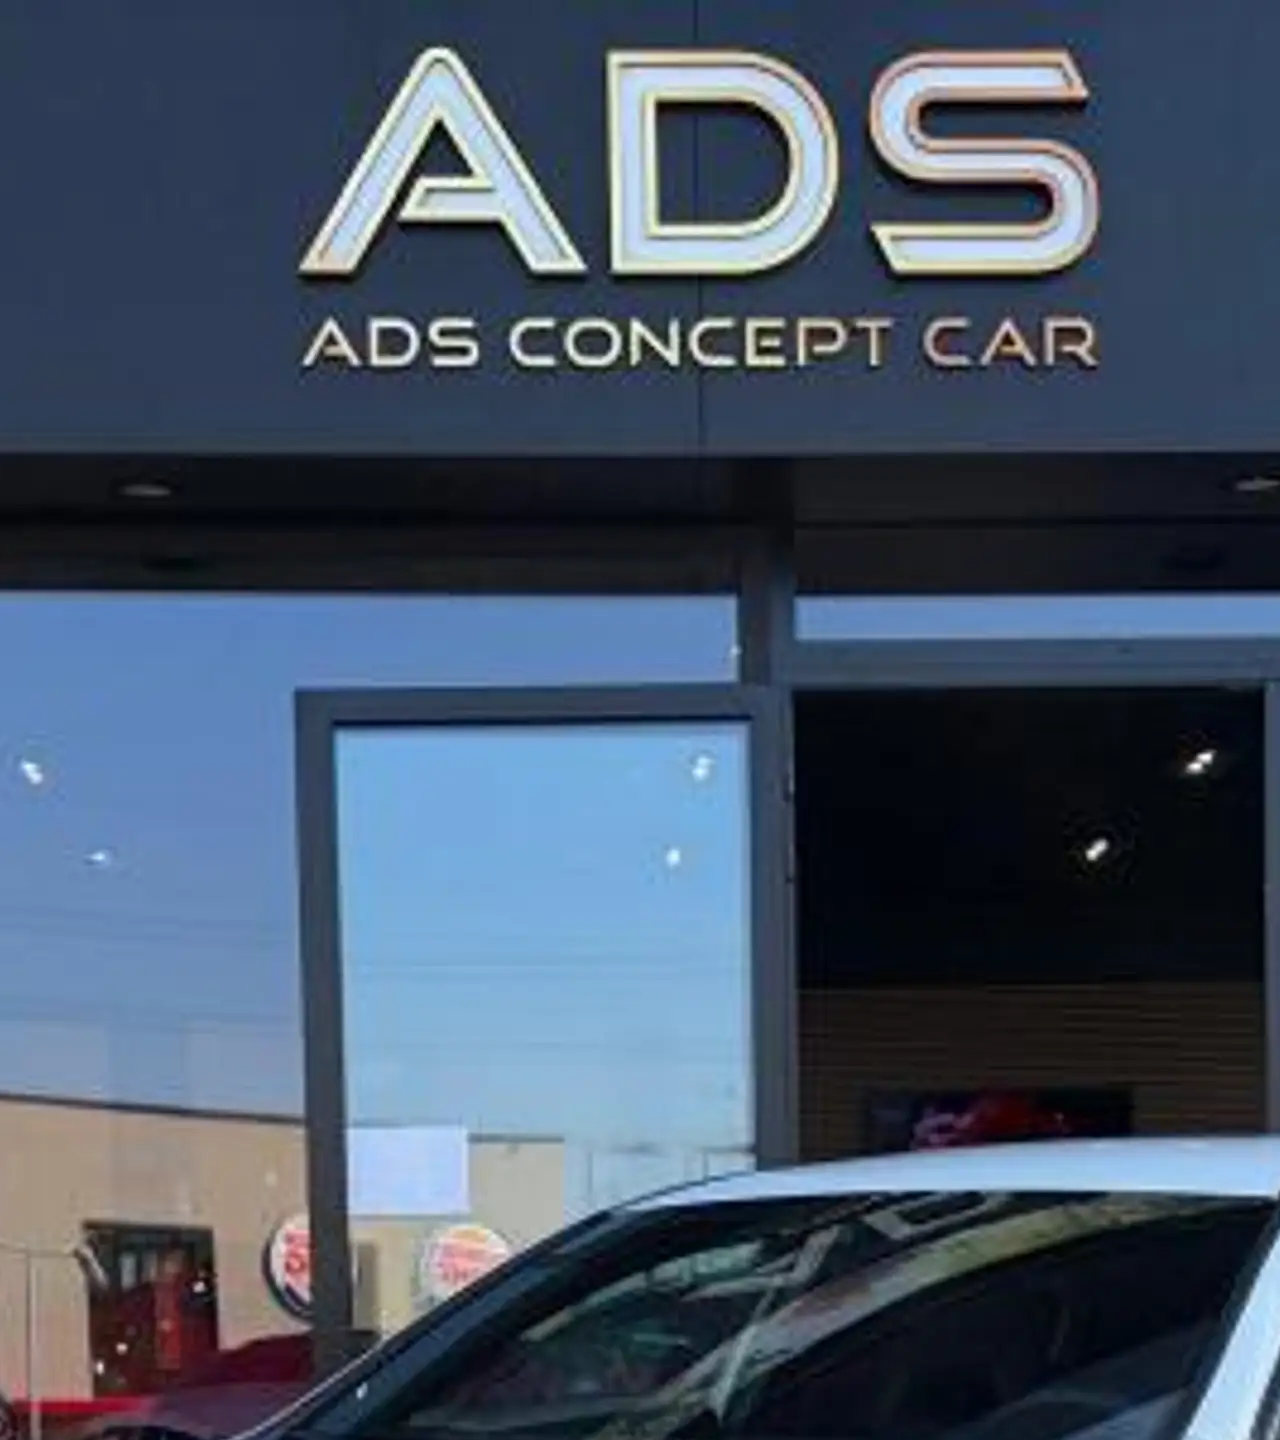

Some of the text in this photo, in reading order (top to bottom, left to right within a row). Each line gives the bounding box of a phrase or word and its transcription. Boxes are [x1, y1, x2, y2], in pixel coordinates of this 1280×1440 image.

[298, 46, 1100, 276] ADS
[302, 317, 1099, 369] ADS CONCEPT CAR
